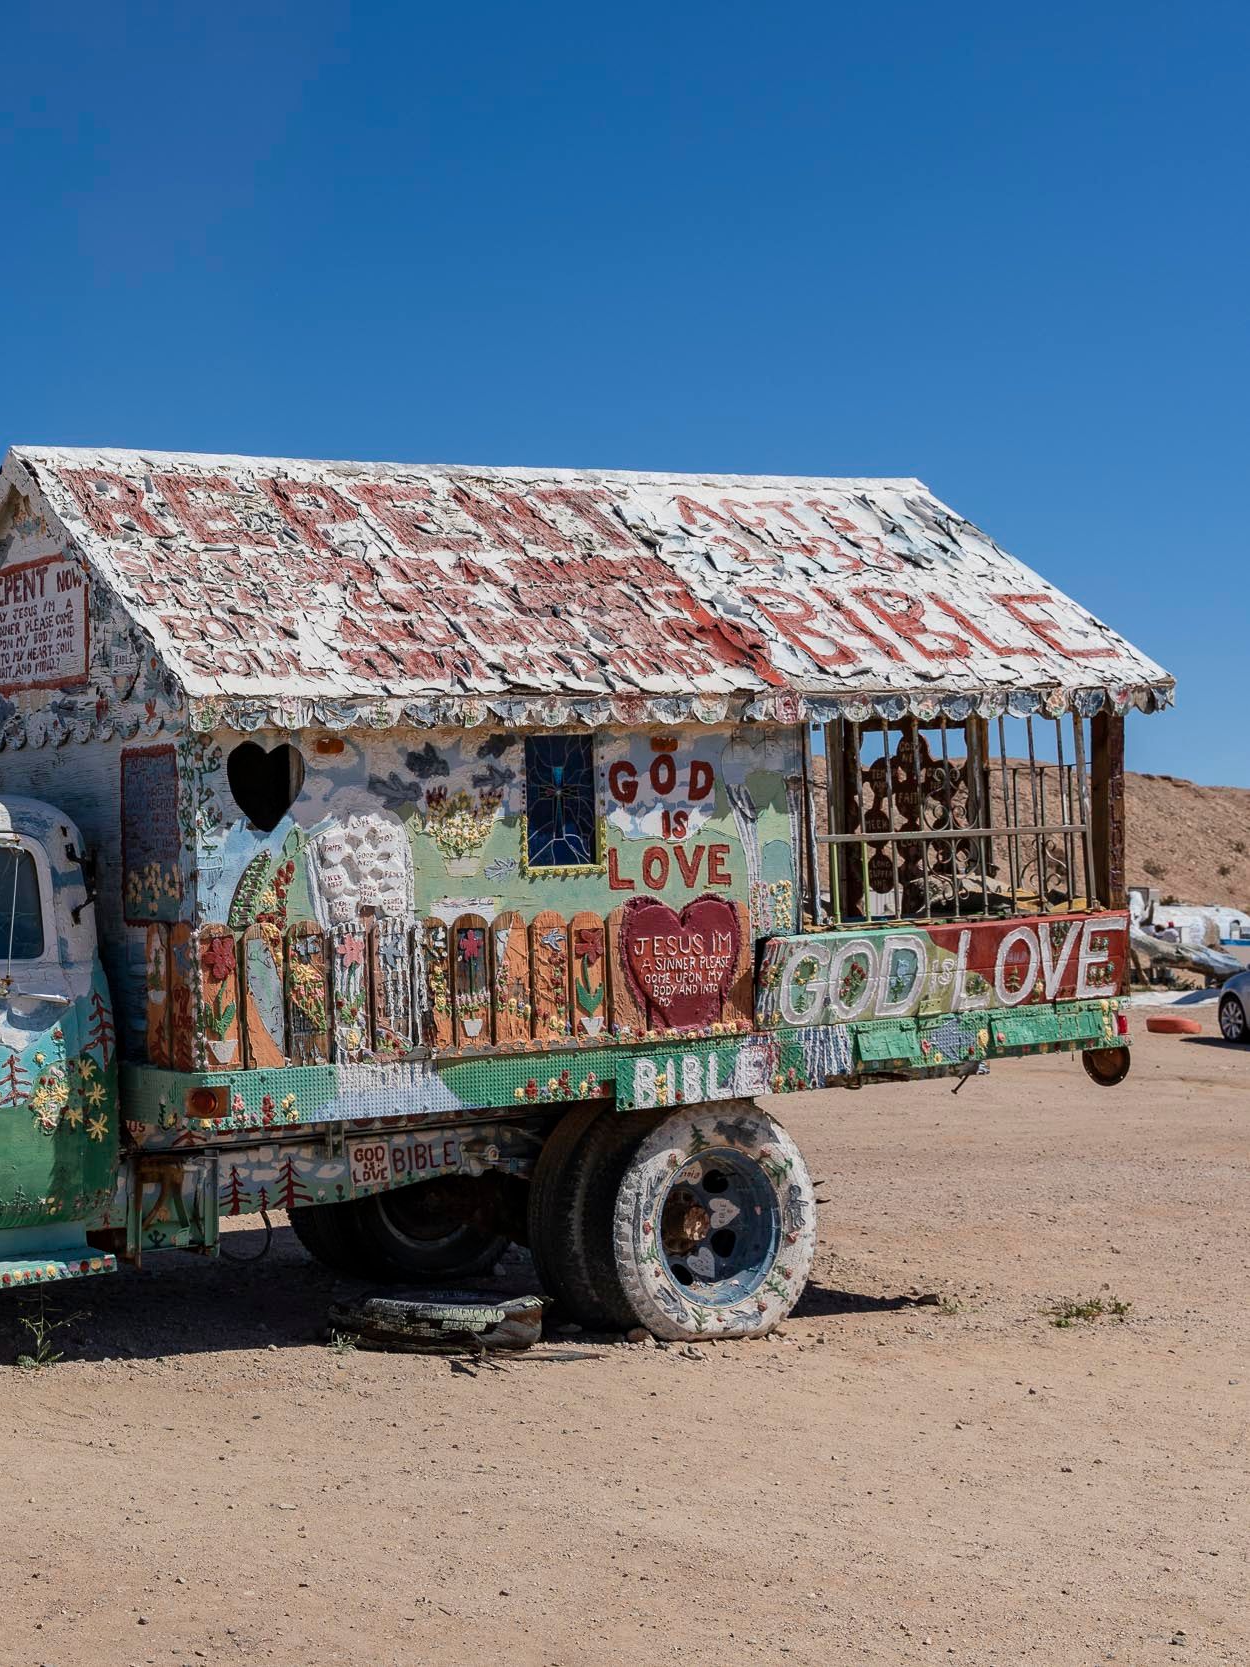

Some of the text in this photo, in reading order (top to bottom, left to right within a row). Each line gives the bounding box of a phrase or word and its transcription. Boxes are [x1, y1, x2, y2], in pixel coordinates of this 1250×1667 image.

[57, 468, 638, 553] REPENT
[673, 494, 862, 534] ACTS
[57, 564, 83, 593] NOW
[12, 603, 38, 621] JESUS
[66, 598, 73, 610] A
[24, 615, 54, 633] PLEASE
[55, 610, 74, 625] COME
[16, 635, 29, 648] MY
[33, 628, 52, 645] BODY
[56, 625, 75, 639] AND
[737, 584, 1121, 667] BIBLE
[13, 650, 25, 662] MY
[56, 640, 74, 655] SOUL
[15, 662, 31, 675] AND
[608, 753, 715, 804] GOD
[661, 809, 689, 840] IS
[607, 843, 732, 891] LOVE
[634, 932, 705, 957] JESUS
[640, 955, 730, 973] A SINNER PLEASE
[779, 934, 929, 1025] GOD
[951, 917, 1128, 1011] LOVE
[675, 971, 702, 984] UPON
[707, 970, 724, 982] MY
[652, 982, 719, 998] BODY AND INTO
[632, 1046, 774, 1110] BIBLE
[354, 1145, 385, 1164] GOD
[392, 1140, 457, 1174] BIBLE
[352, 1167, 388, 1184] LOVE
